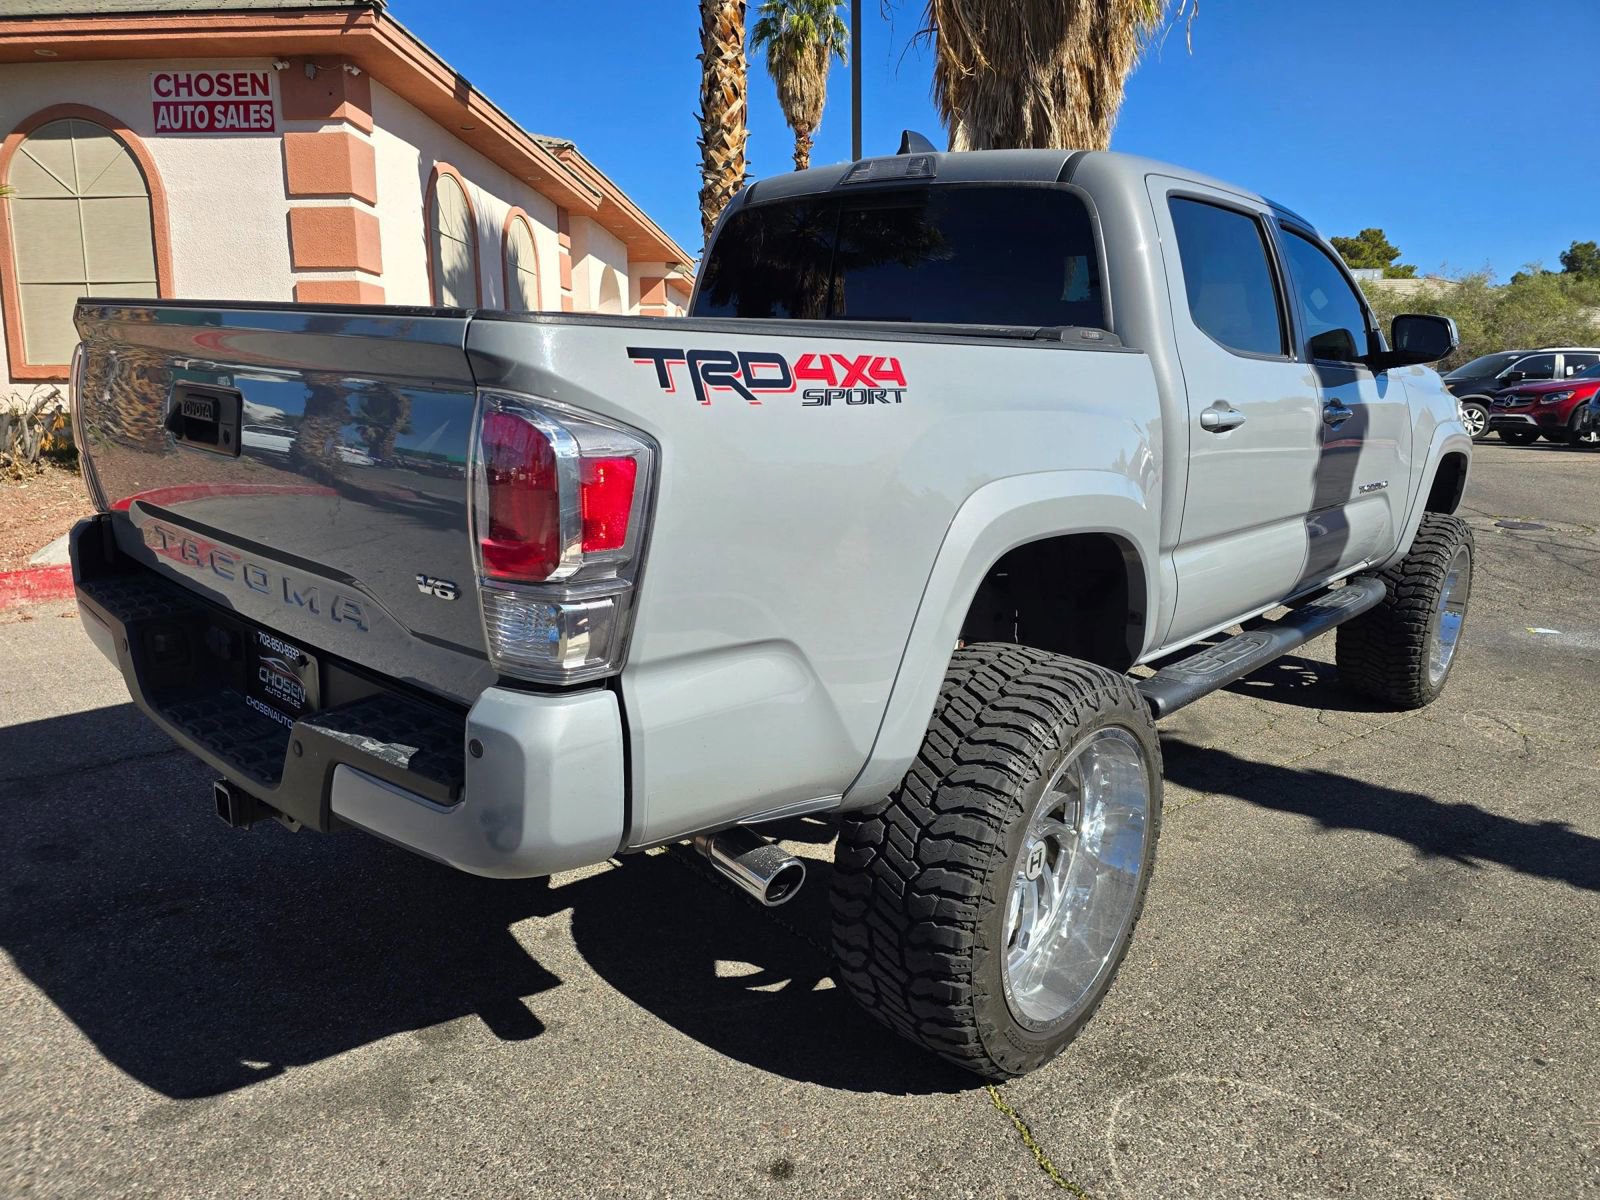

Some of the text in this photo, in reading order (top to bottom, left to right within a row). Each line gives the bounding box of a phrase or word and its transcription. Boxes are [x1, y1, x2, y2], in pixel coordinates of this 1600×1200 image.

[153, 72, 270, 98] CHOSEN
[156, 104, 273, 130] AUTO SALES
[626, 346, 798, 406] TRD
[181, 399, 213, 418] TOYOTA
[802, 387, 908, 406] SPORT
[153, 524, 370, 633] TACOMA
[416, 574, 458, 601] V6
[259, 667, 306, 703] CHOSEN
[264, 685, 301, 709] AUTO SALES
